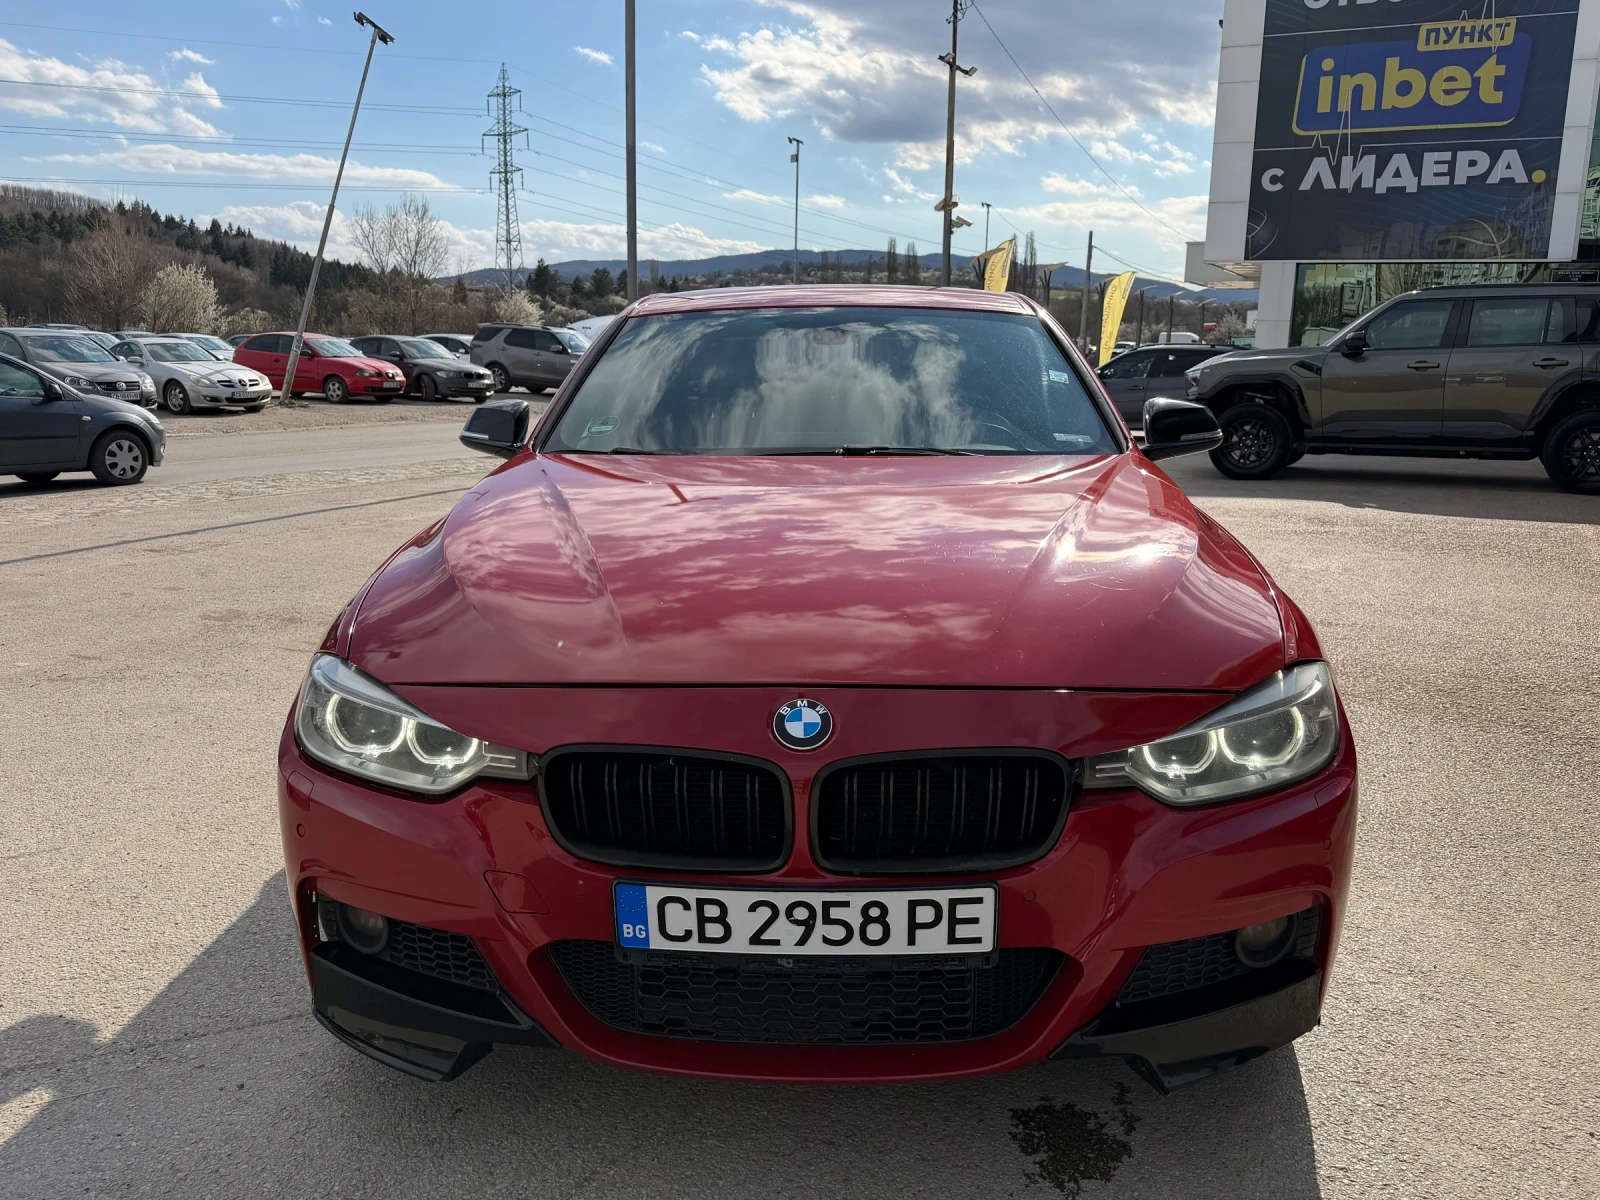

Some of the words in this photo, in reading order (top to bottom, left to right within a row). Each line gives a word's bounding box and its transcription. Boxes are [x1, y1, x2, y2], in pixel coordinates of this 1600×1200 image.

[1425, 22, 1511, 46] ПУНКТ
[1316, 53, 1507, 114] inbet
[1298, 149, 1547, 194] ЛИДЕРА.
[780, 700, 827, 716] BMW
[622, 923, 646, 939] BG
[656, 895, 732, 945] CB
[747, 900, 891, 947] 2958
[907, 897, 984, 946] PE
